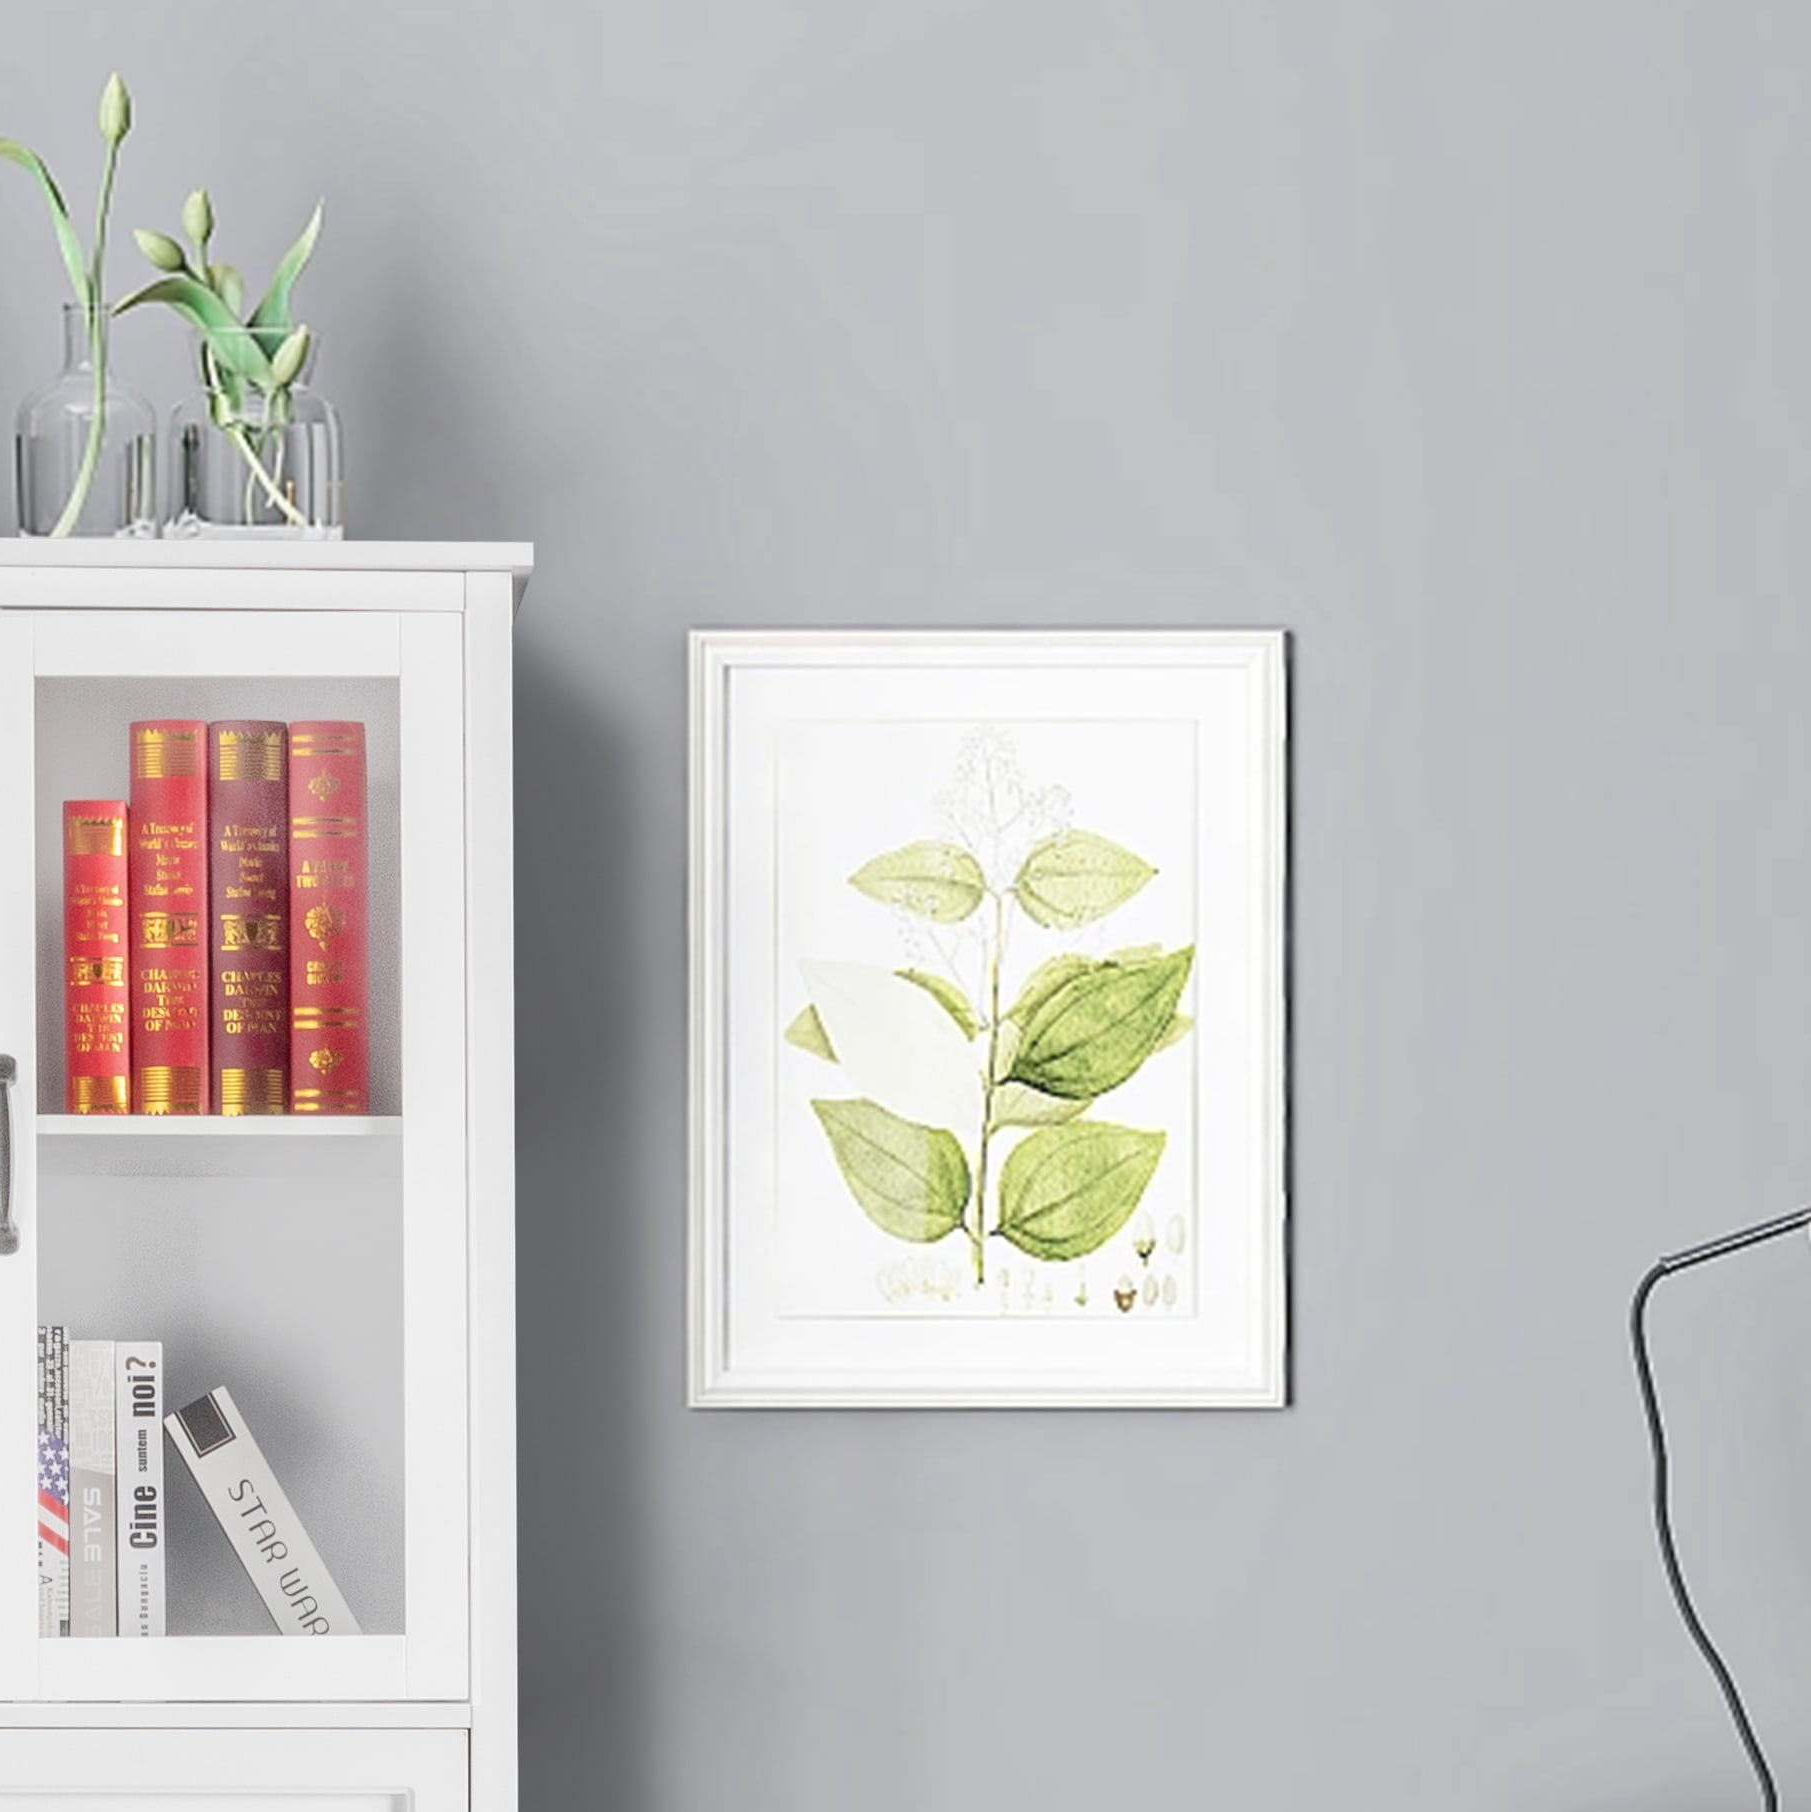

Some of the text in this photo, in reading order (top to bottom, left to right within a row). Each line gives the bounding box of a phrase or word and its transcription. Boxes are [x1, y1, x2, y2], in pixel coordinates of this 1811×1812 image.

[125, 1356, 157, 1418] noi?
[138, 1428, 148, 1473] suntem
[129, 1485, 158, 1549] Cine
[228, 1479, 288, 1564] STAR
